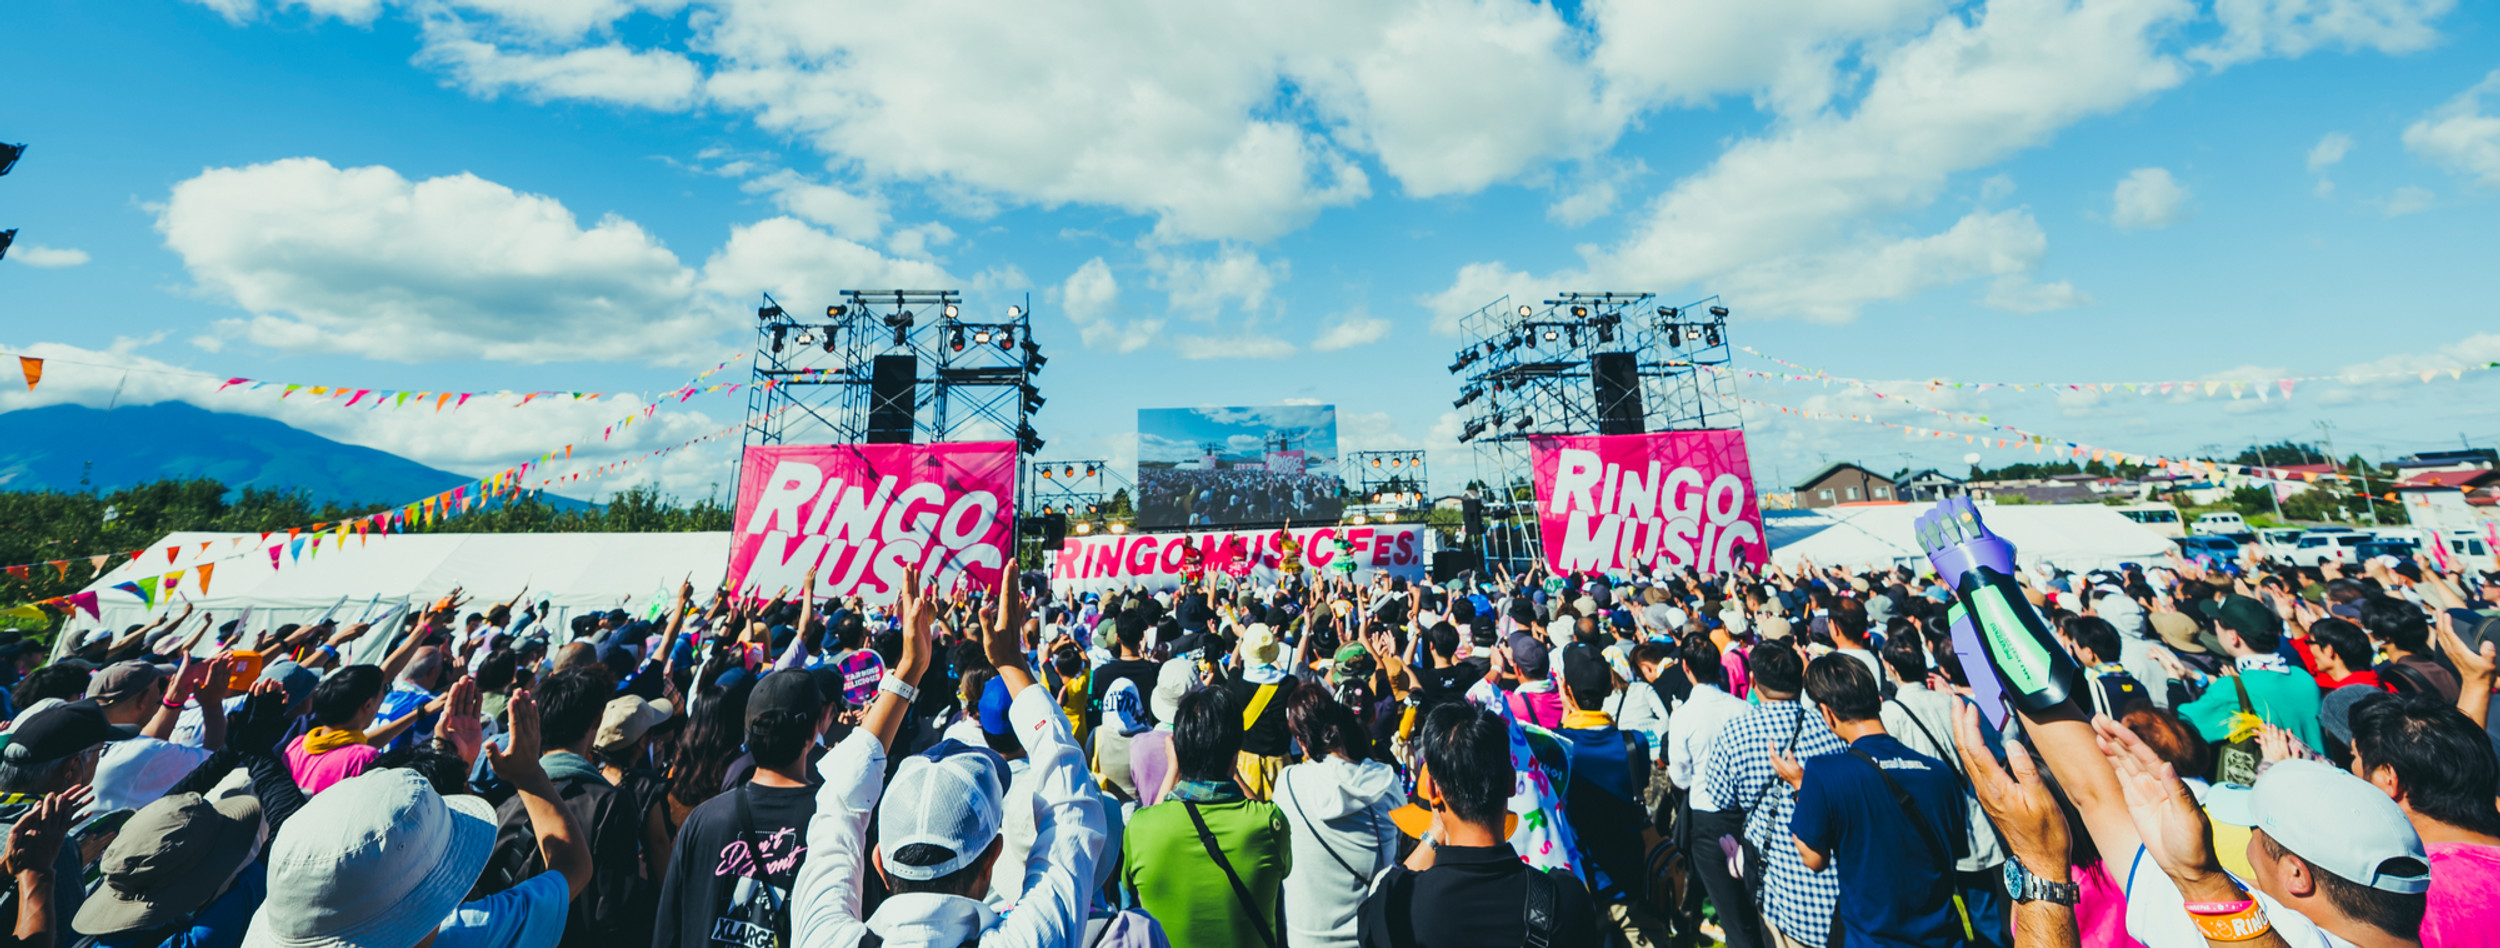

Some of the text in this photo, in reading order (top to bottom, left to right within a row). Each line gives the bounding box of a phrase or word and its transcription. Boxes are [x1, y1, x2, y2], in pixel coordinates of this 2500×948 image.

[746, 461, 998, 550] RINGO
[1551, 448, 1745, 527] RINGO
[738, 530, 1002, 606] MUSIC
[1052, 536, 1185, 579] RINGO
[1347, 528, 1419, 566] FES.
[1558, 510, 1759, 577] MUSIC
[715, 827, 796, 876] Dn't
